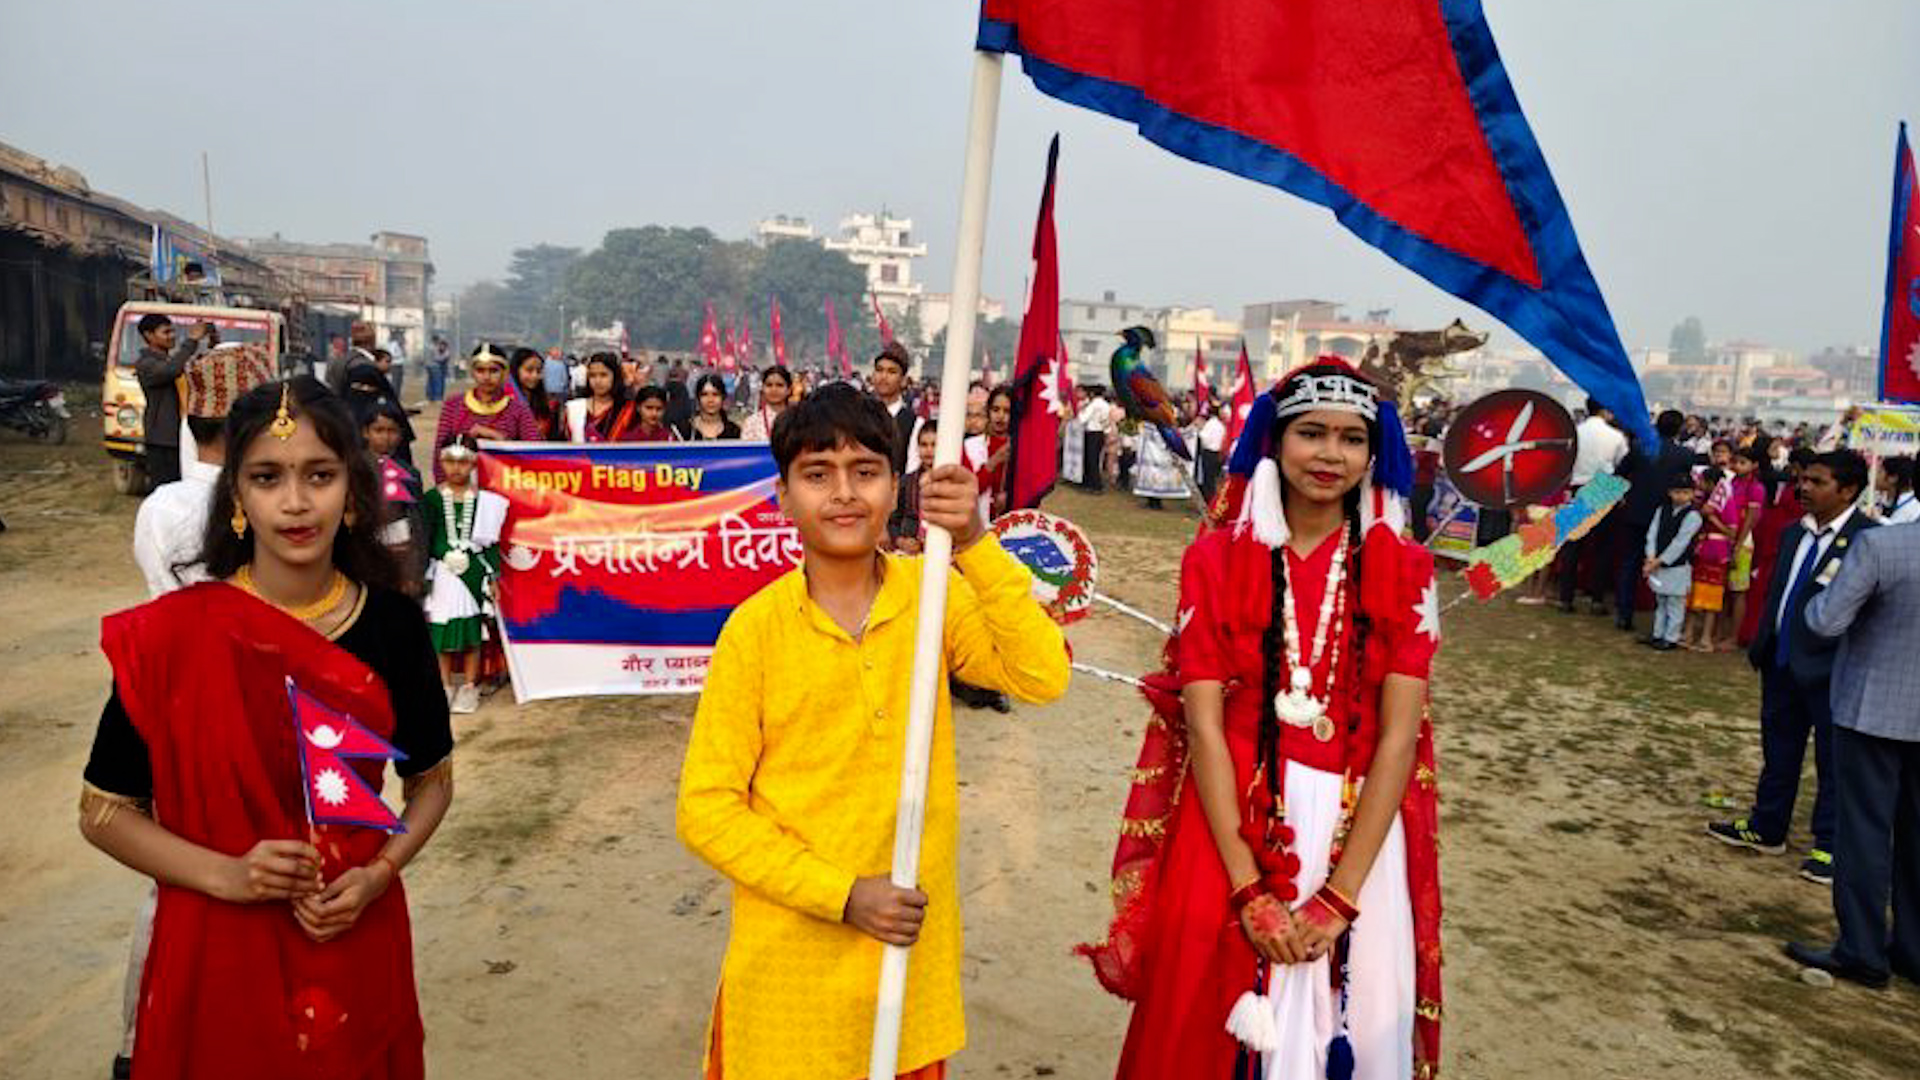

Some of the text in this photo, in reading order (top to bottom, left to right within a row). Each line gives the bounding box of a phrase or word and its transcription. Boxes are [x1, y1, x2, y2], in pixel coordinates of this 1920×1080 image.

[503, 463, 704, 493] Happy Flag Day
